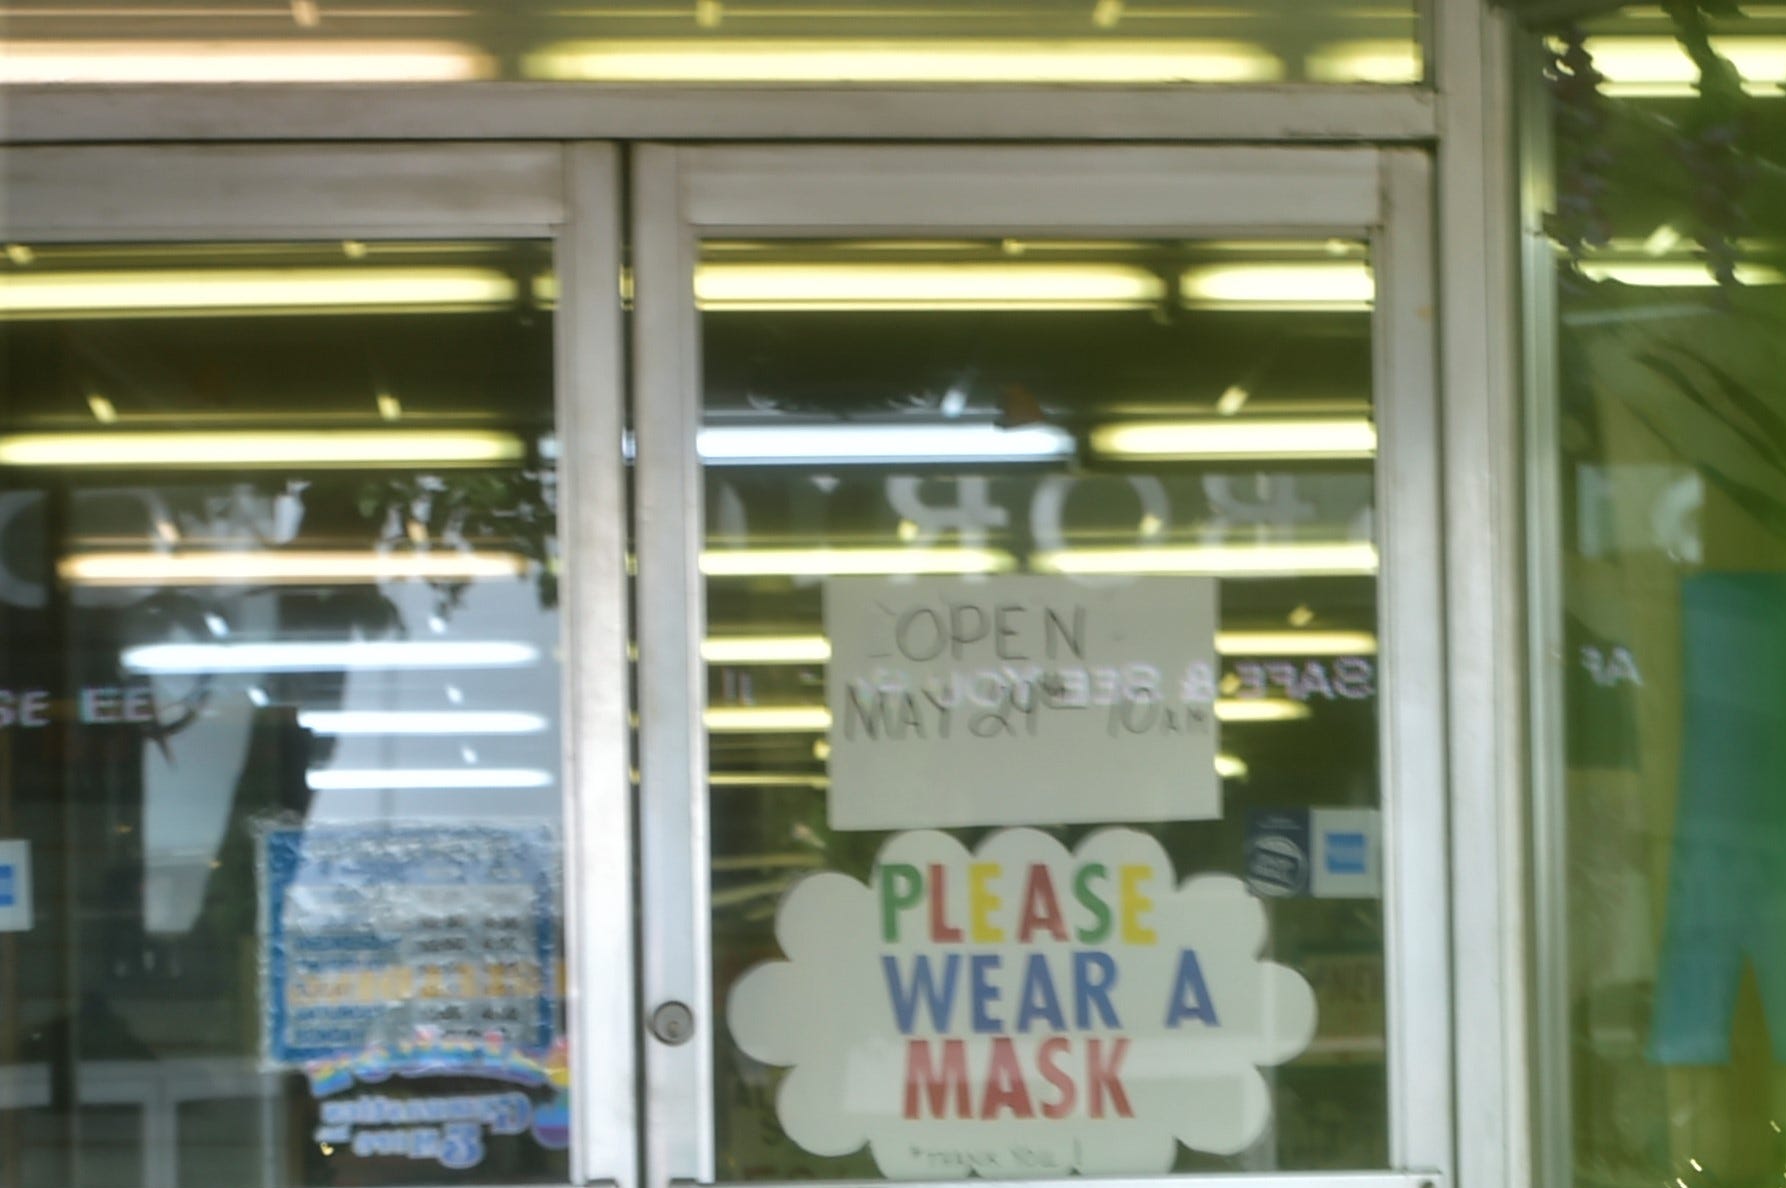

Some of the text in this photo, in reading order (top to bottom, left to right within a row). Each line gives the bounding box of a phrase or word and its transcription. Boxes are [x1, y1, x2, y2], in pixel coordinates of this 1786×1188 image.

[895, 604, 1086, 662] OPEN
[844, 678, 953, 742] MAY
[879, 862, 1157, 946] PLEASE
[881, 947, 1222, 1034] WEAR A
[902, 1036, 1136, 1121] MASK
